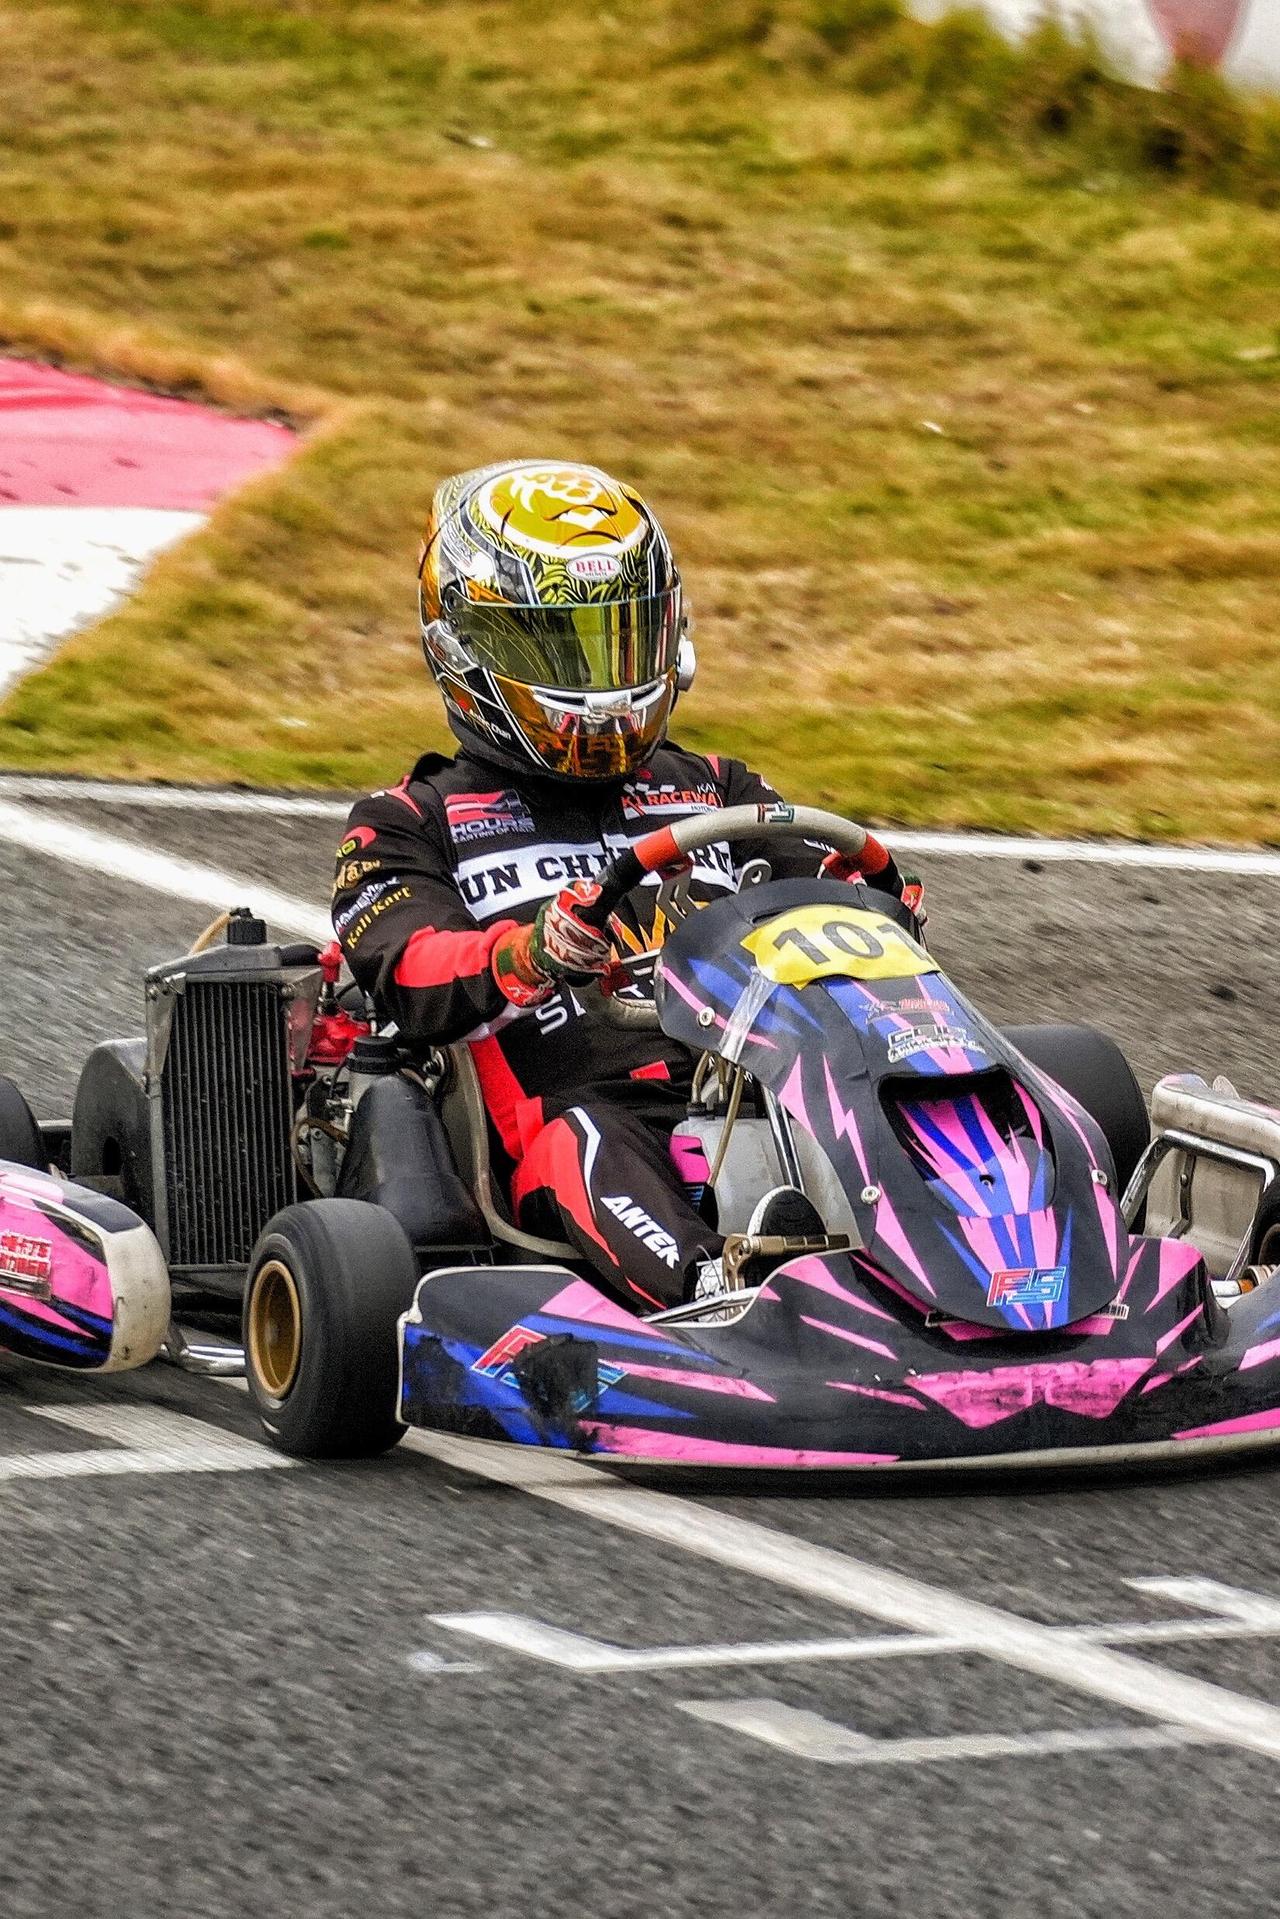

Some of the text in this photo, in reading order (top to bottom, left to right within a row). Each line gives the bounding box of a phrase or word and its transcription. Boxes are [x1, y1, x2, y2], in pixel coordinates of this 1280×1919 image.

[575, 559, 616, 573] BELL
[371, 886, 412, 915] Kart
[772, 921, 929, 965] 101
[600, 1196, 680, 1269] ANTEK
